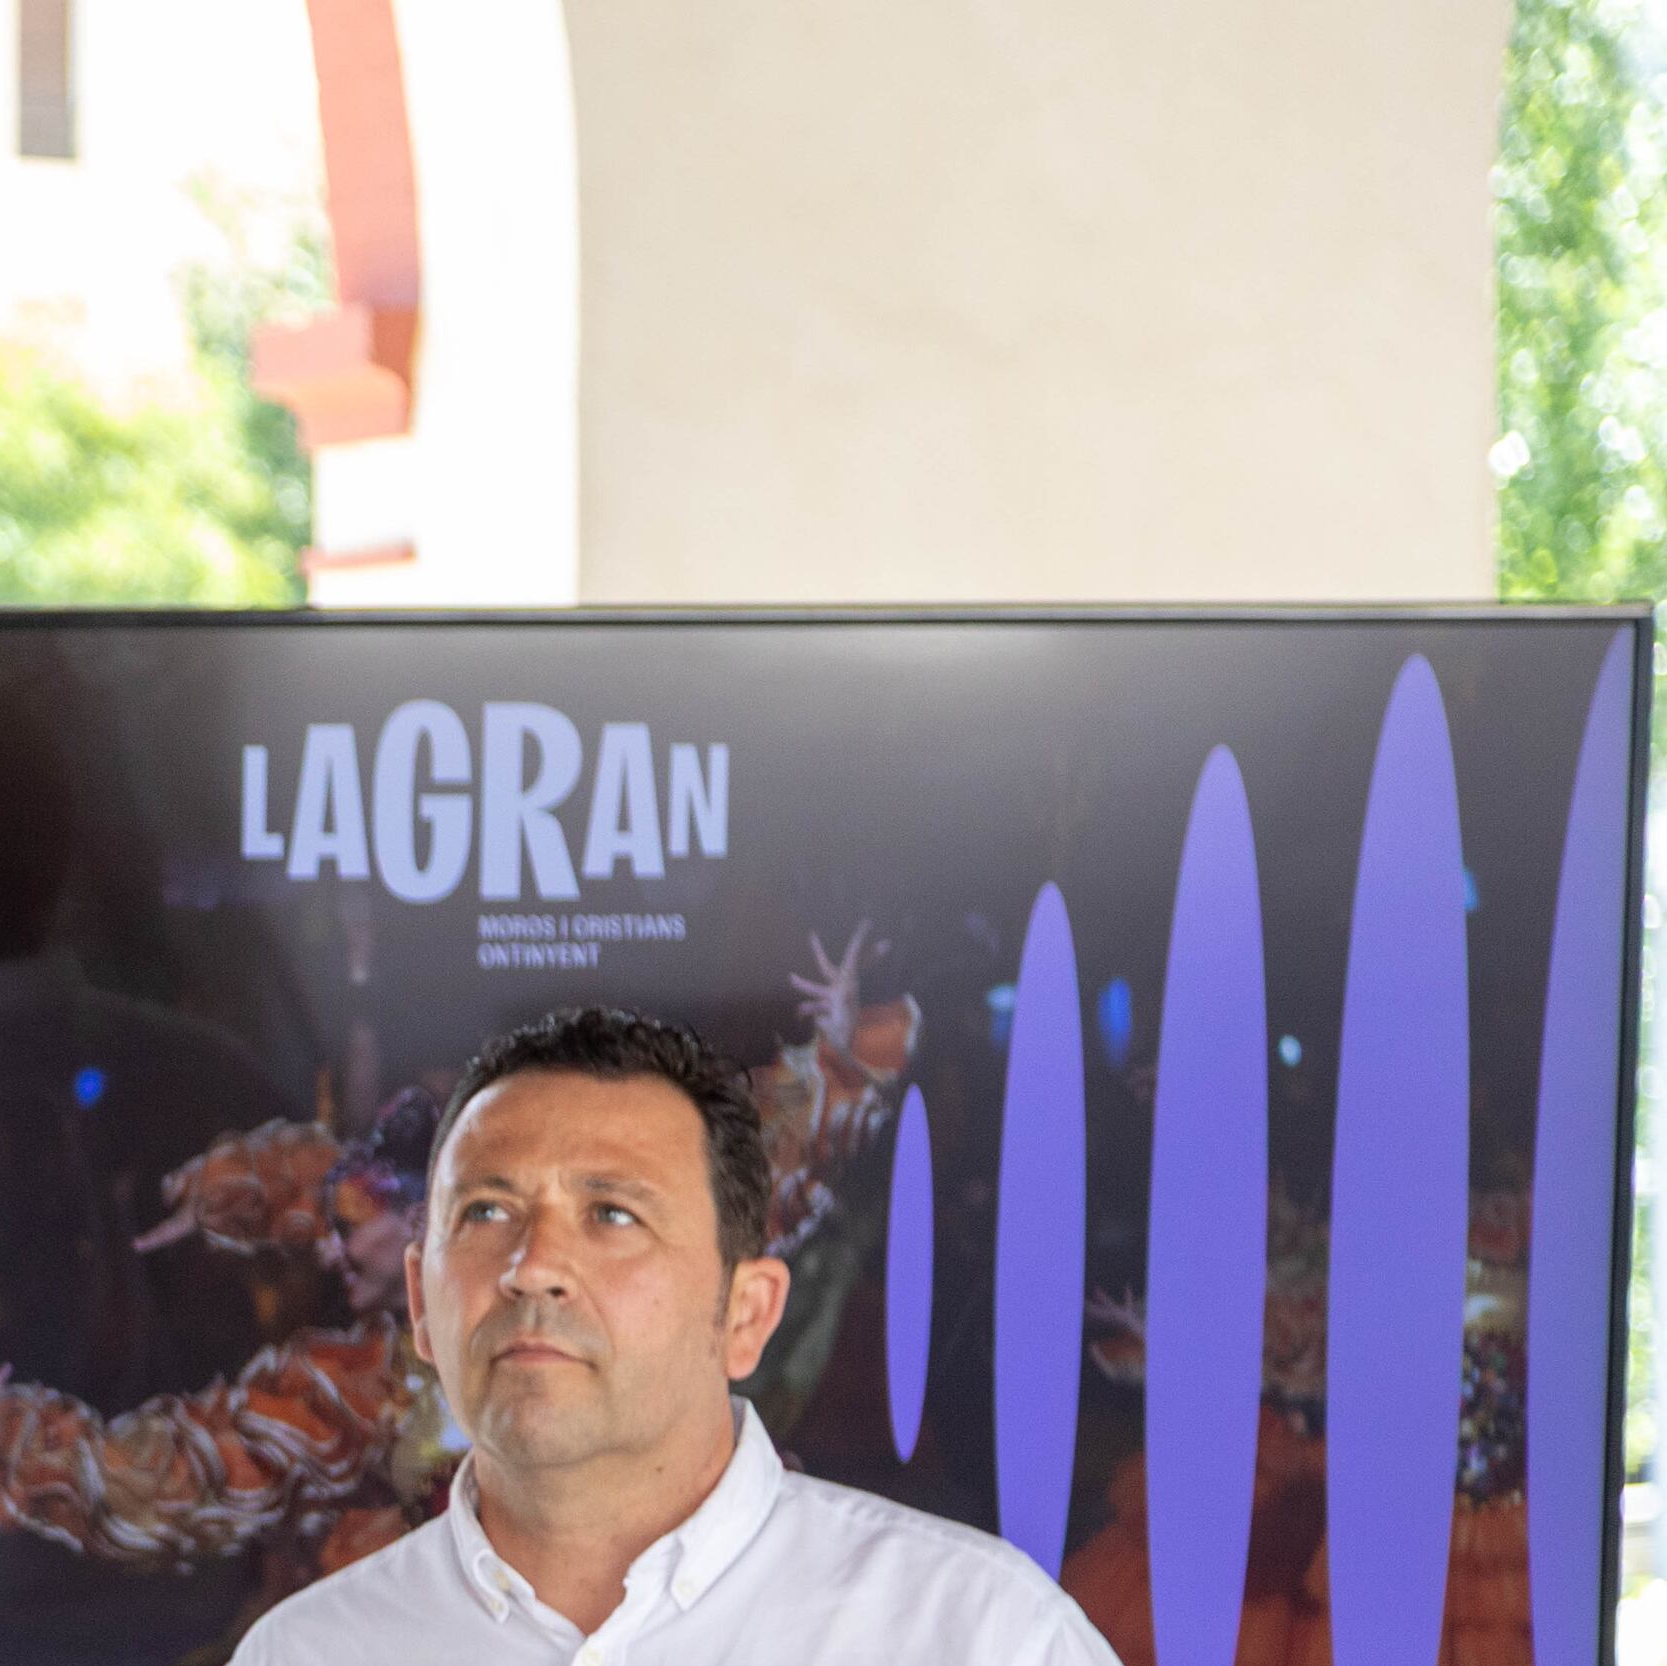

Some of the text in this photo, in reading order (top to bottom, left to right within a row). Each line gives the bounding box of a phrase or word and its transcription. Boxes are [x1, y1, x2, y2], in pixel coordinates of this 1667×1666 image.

[241, 699, 730, 902] LAGRAN
[478, 914, 556, 941] MOROS
[571, 913, 686, 941] CRISTIANS
[478, 942, 599, 969] ONTINYENT
